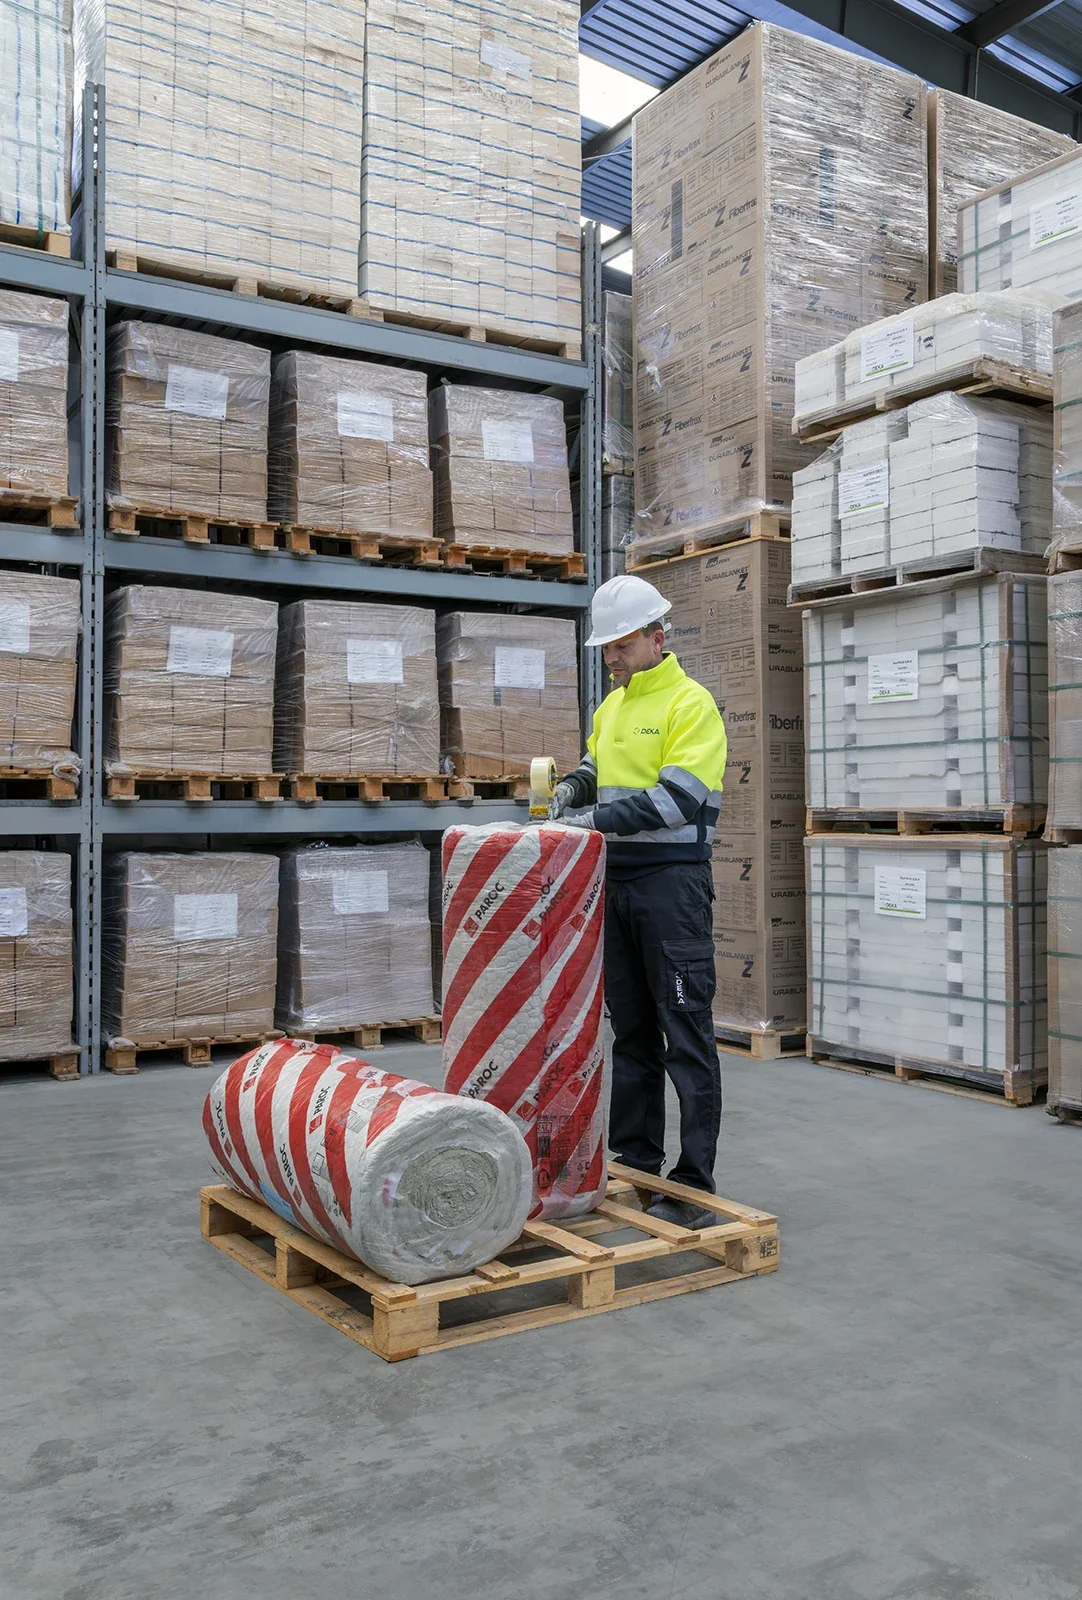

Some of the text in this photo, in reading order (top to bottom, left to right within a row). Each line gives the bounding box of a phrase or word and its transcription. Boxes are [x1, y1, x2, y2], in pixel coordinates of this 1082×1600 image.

[738, 60, 751, 84] Z
[715, 206, 726, 228] Z
[707, 247, 753, 276] DURABLANKET
[740, 255, 752, 277] Z
[805, 293, 821, 313] Z
[903, 286, 917, 303] Z
[661, 328, 672, 349] Z
[707, 344, 754, 369] DURABLANKET
[740, 352, 753, 373] Z
[871, 363, 885, 372] DEKA
[662, 418, 673, 437] Z
[708, 440, 756, 462] DURABLANKET
[740, 448, 754, 469] Z
[663, 508, 674, 526] Z
[704, 565, 751, 582] DURABLANKET
[736, 572, 749, 592] Z
[739, 766, 752, 785] Z
[739, 863, 752, 882] Z
[474, 881, 505, 920] PAROC
[538, 883, 571, 922] PAROC
[583, 875, 602, 914] PAROC
[741, 960, 755, 979] Z
[675, 979, 685, 1005] DEKA
[468, 1059, 499, 1099] PAROC
[312, 1085, 331, 1116] PAROC
[279, 1143, 295, 1187] PAROC
